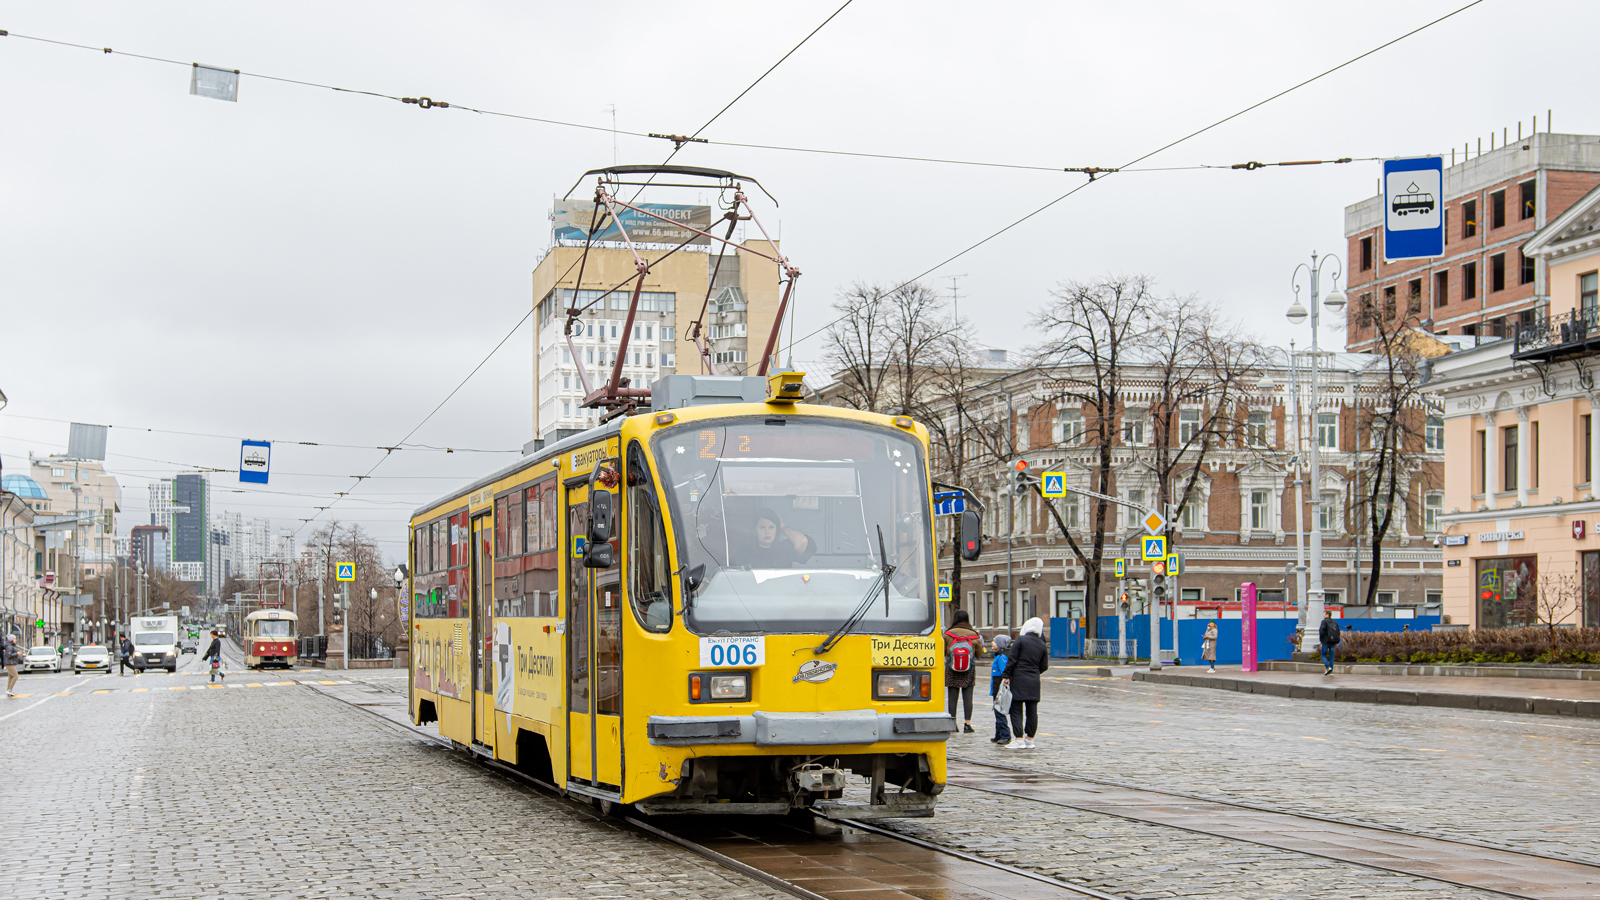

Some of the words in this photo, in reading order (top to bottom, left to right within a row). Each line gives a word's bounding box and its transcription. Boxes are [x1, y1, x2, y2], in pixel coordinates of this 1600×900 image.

[632, 208, 692, 220] ТЕЛЕПРОЕКТ
[632, 228, 692, 239] www.66.мвд.рф
[700, 430, 716, 458] 2
[738, 435, 750, 452] 2
[871, 638, 890, 652] Три
[892, 639, 936, 652] Десятки
[517, 645, 527, 678] Три
[527, 646, 554, 680] Десятки
[710, 644, 757, 666] 006
[882, 656, 935, 667] 310-10-10
